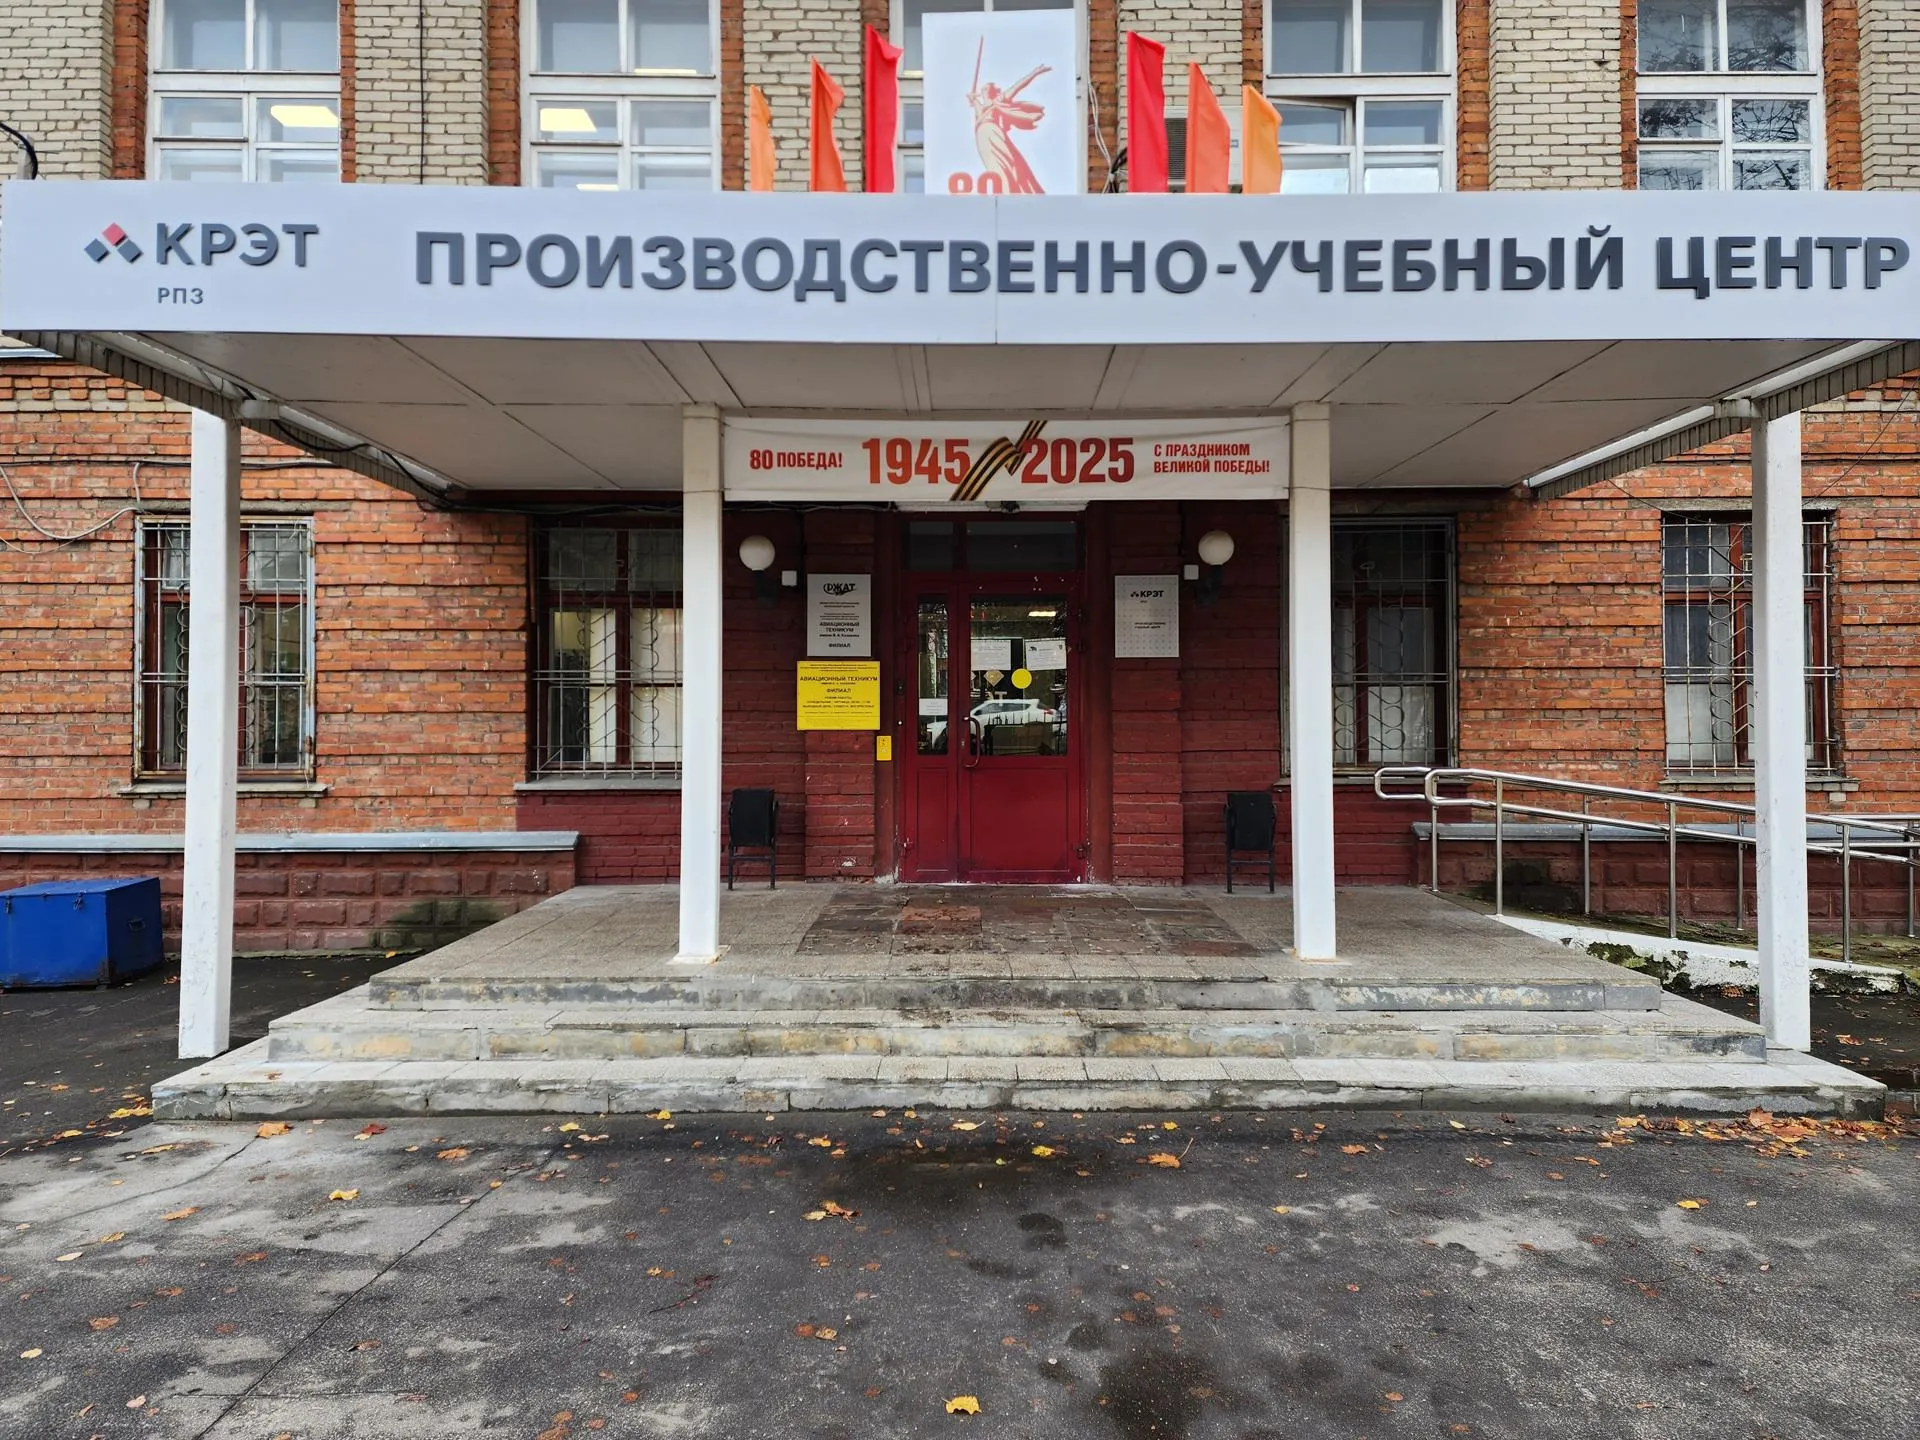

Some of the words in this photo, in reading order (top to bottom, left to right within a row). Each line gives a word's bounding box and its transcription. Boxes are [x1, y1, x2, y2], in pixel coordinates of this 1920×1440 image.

[157, 222, 320, 268] КРЭТ
[415, 225, 1624, 302] ПРОИЗВОДСТВЕННО-УЧЕБНЫЙ
[1655, 236, 1911, 299] ЦЕНТР
[157, 287, 204, 305] РПЗ
[750, 449, 774, 470] 80
[777, 450, 843, 469] ПОБЕДА!
[862, 437, 971, 485] 1945
[1020, 437, 1134, 485] 2025
[1153, 443, 1161, 457] С
[1165, 442, 1251, 458] ПРАЗДНИКОМ
[1153, 458, 1210, 475] ВЕЛИКОЙ
[1213, 457, 1270, 475] ПОБЕДЫ!
